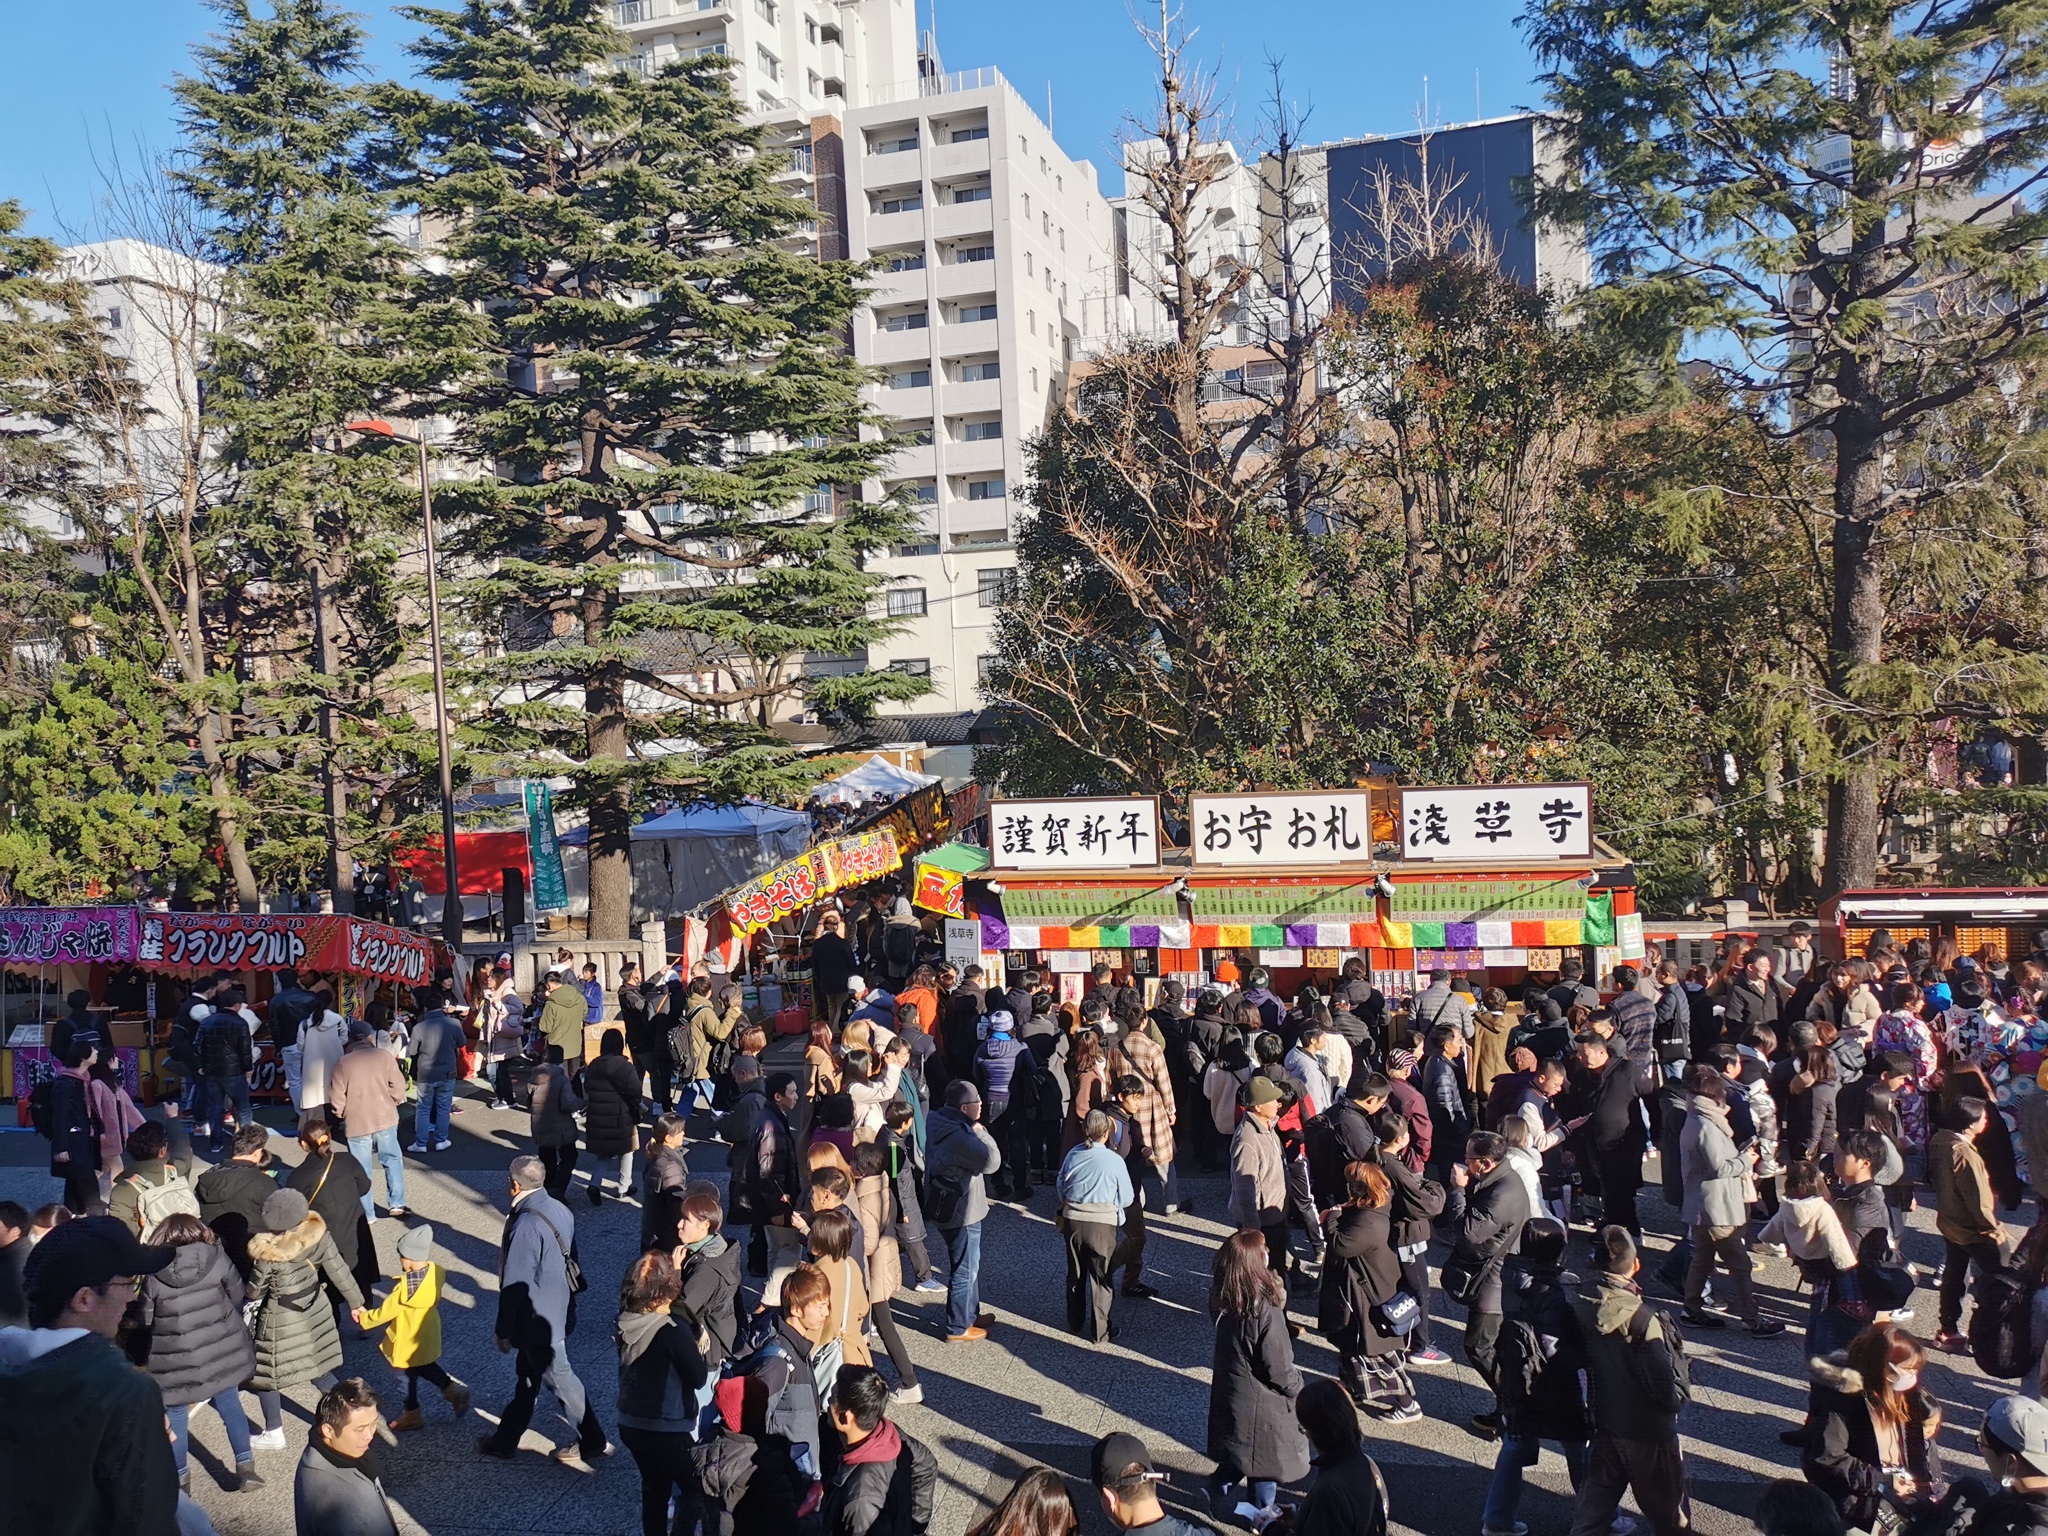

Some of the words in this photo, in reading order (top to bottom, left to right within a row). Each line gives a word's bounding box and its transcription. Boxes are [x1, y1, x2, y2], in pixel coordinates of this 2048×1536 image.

[998, 811, 1149, 856] 謹賀新年
[729, 865, 815, 932] やきそば
[168, 929, 305, 967] フランクフルト
[949, 927, 974, 939] 浅草寺
[360, 936, 425, 982] フランクフルト
[950, 955, 974, 967] お守り
